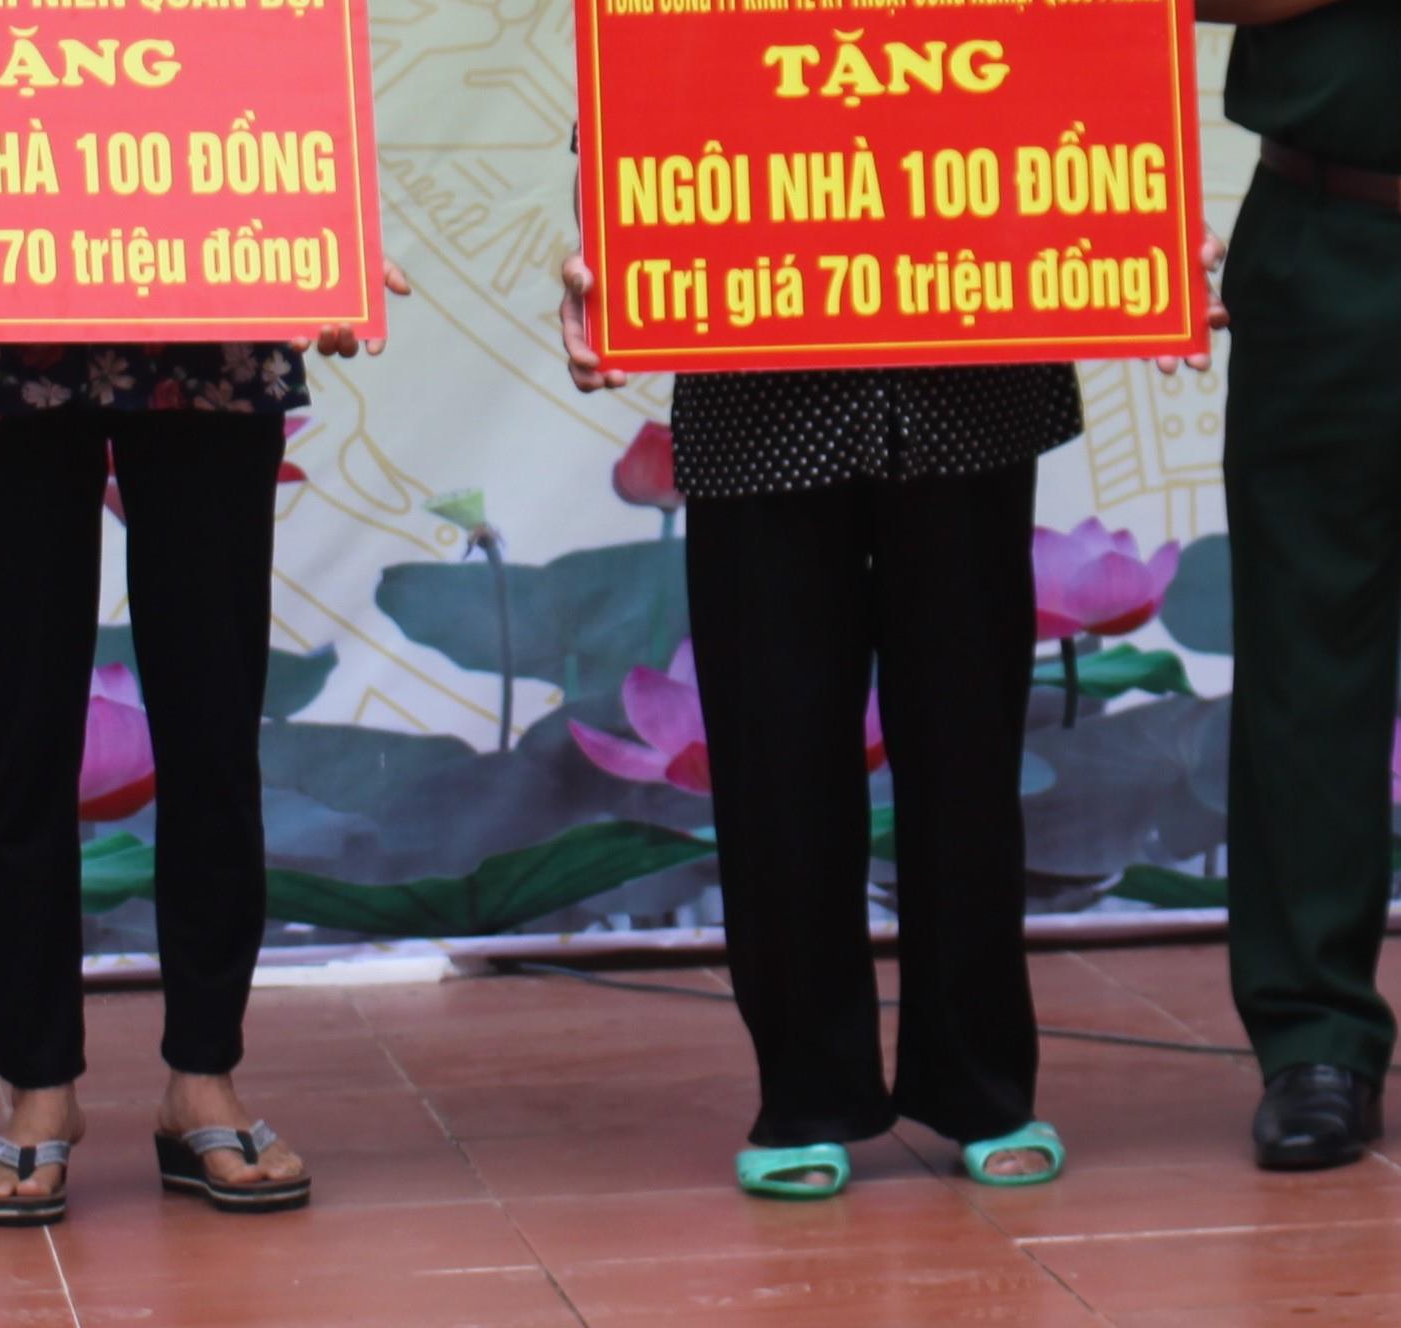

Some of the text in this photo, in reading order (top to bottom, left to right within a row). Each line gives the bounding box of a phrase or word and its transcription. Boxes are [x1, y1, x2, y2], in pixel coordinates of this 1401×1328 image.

[764, 30, 1010, 107] TẶNG
[75, 132, 173, 196] 100
[187, 111, 337, 195] ĐỒNG
[618, 122, 1167, 225] NGÔI NHÀ 100 ĐỒNG
[70, 227, 187, 297] triệu
[201, 219, 340, 292] đồng)
[626, 238, 1169, 333] (Trị giá 70 triệu đồng)
